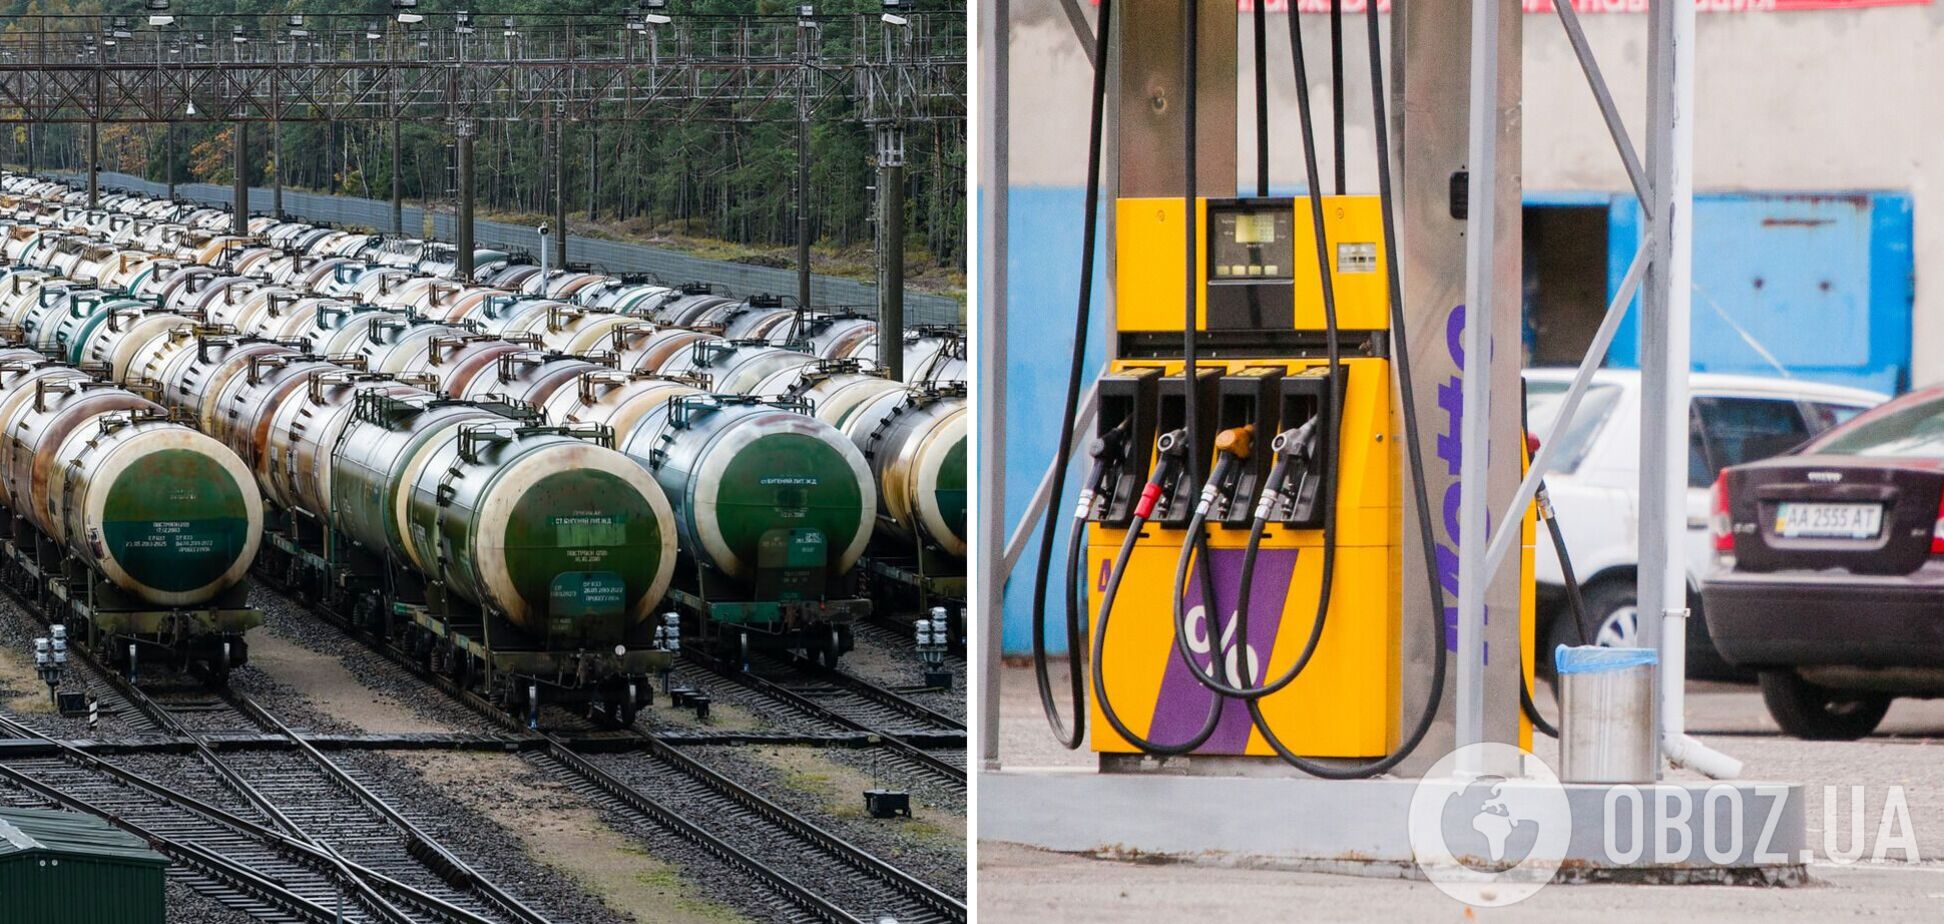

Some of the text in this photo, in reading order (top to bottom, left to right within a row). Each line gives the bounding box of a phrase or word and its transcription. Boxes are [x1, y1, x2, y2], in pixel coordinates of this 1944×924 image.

[1787, 507, 1875, 527] AA 2555 AT
